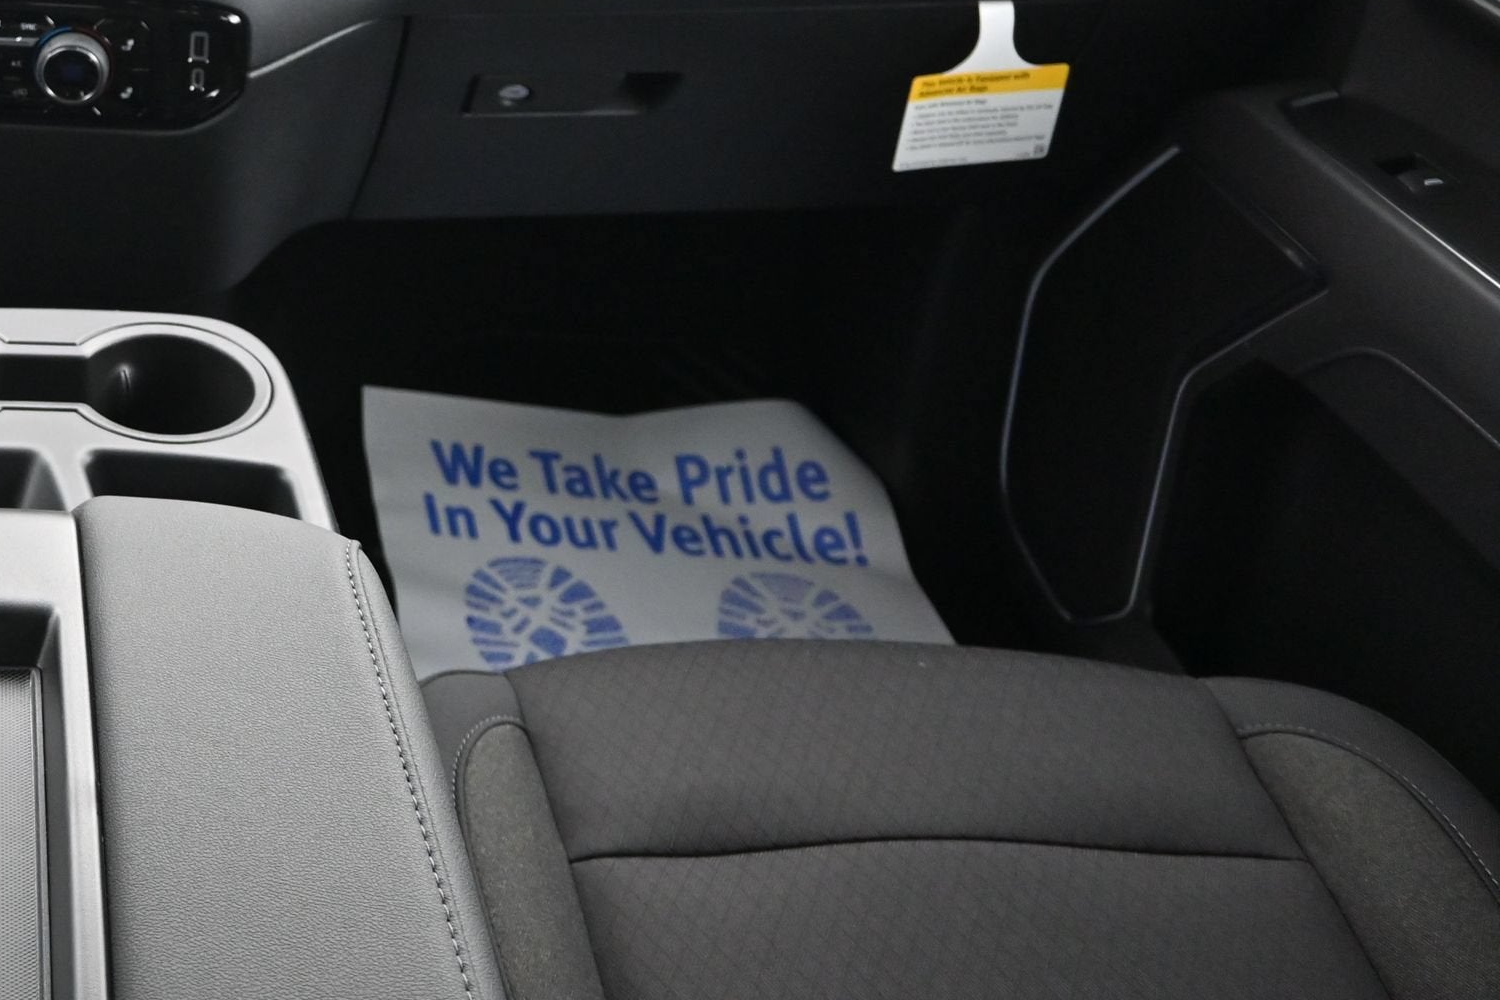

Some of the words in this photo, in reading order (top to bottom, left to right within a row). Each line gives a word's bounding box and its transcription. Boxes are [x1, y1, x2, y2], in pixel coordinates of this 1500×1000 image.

[20, 22, 37, 31] SYNC
[429, 439, 519, 491] We
[529, 449, 659, 501] Take
[674, 446, 831, 504] Pride
[423, 492, 479, 540] In
[489, 497, 619, 551] Your
[627, 510, 871, 567] Vehicle!
